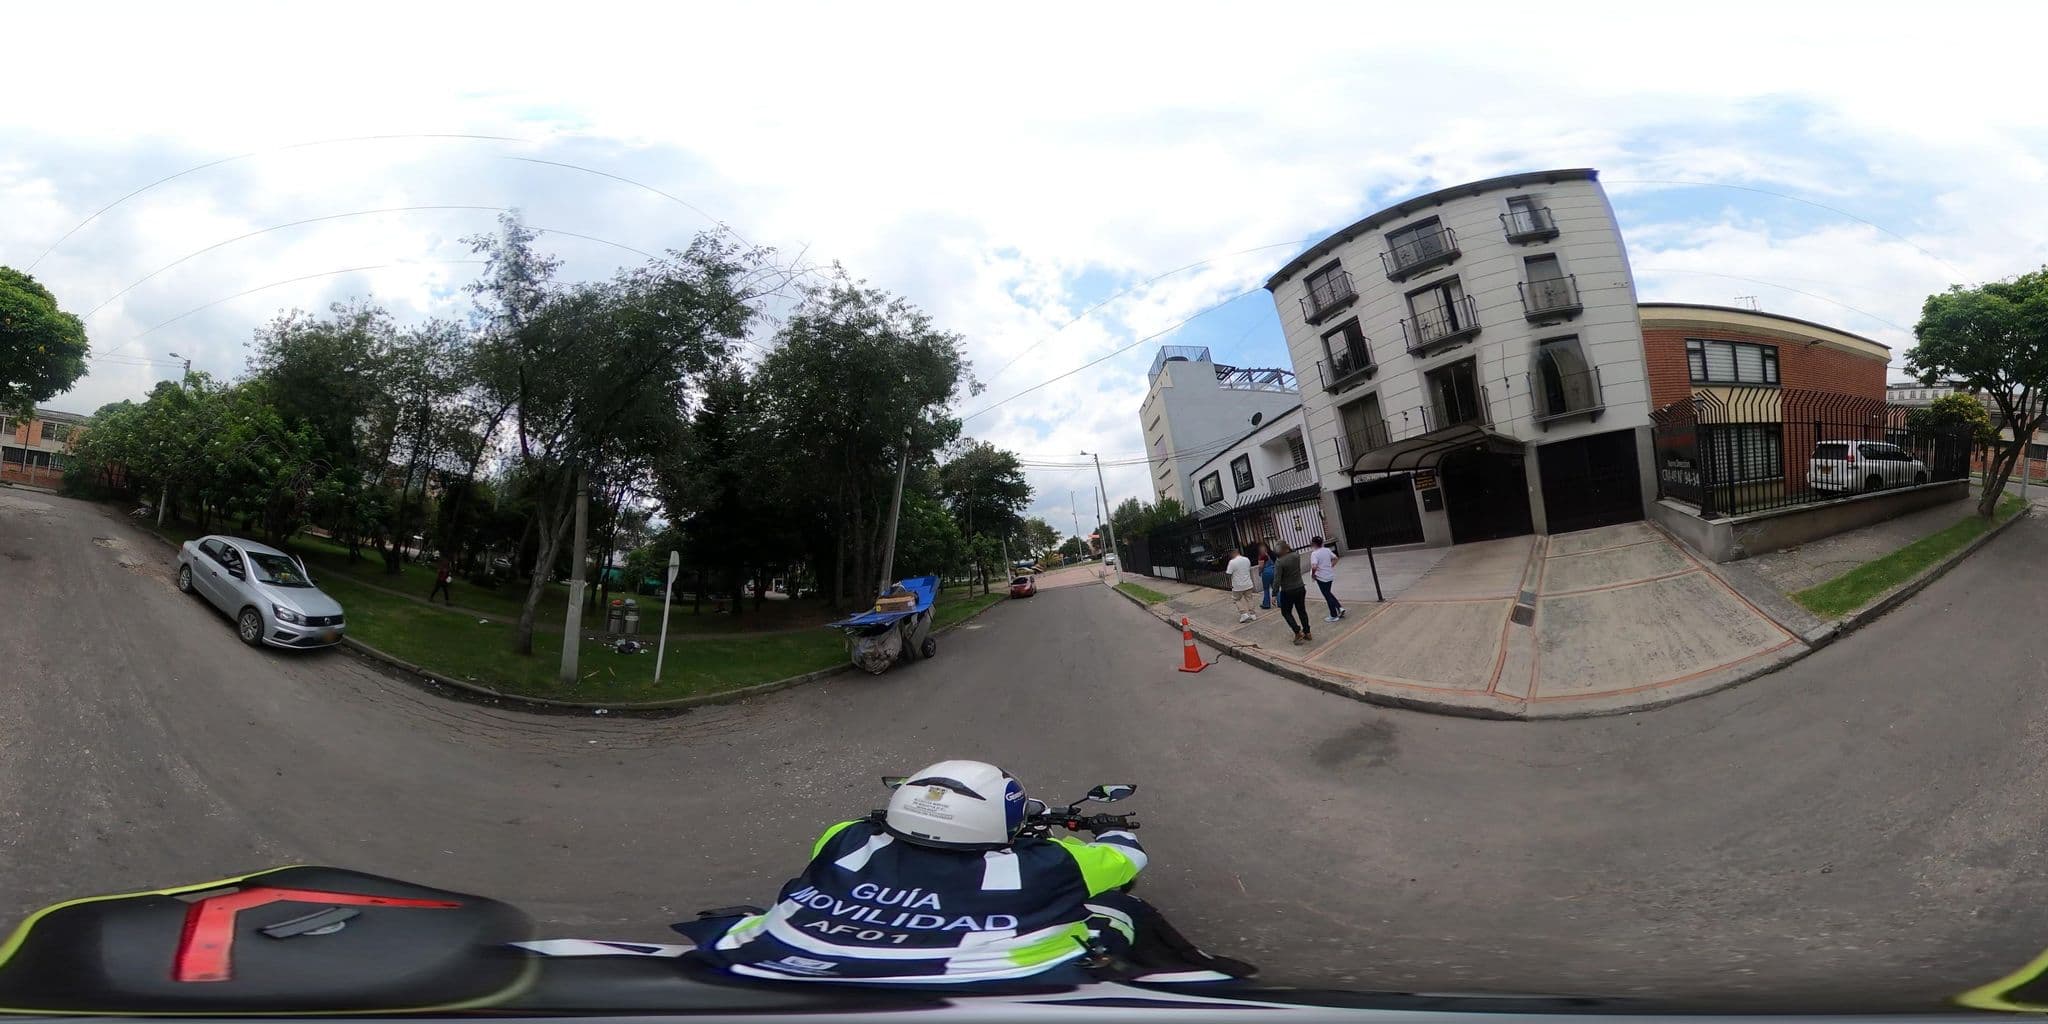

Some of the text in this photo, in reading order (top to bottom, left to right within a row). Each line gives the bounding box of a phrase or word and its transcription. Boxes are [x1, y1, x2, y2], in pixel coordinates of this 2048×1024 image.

[790, 886, 1019, 931] MOVILIDAD
[852, 882, 941, 911] GUÍA
[803, 919, 910, 944] AF01
